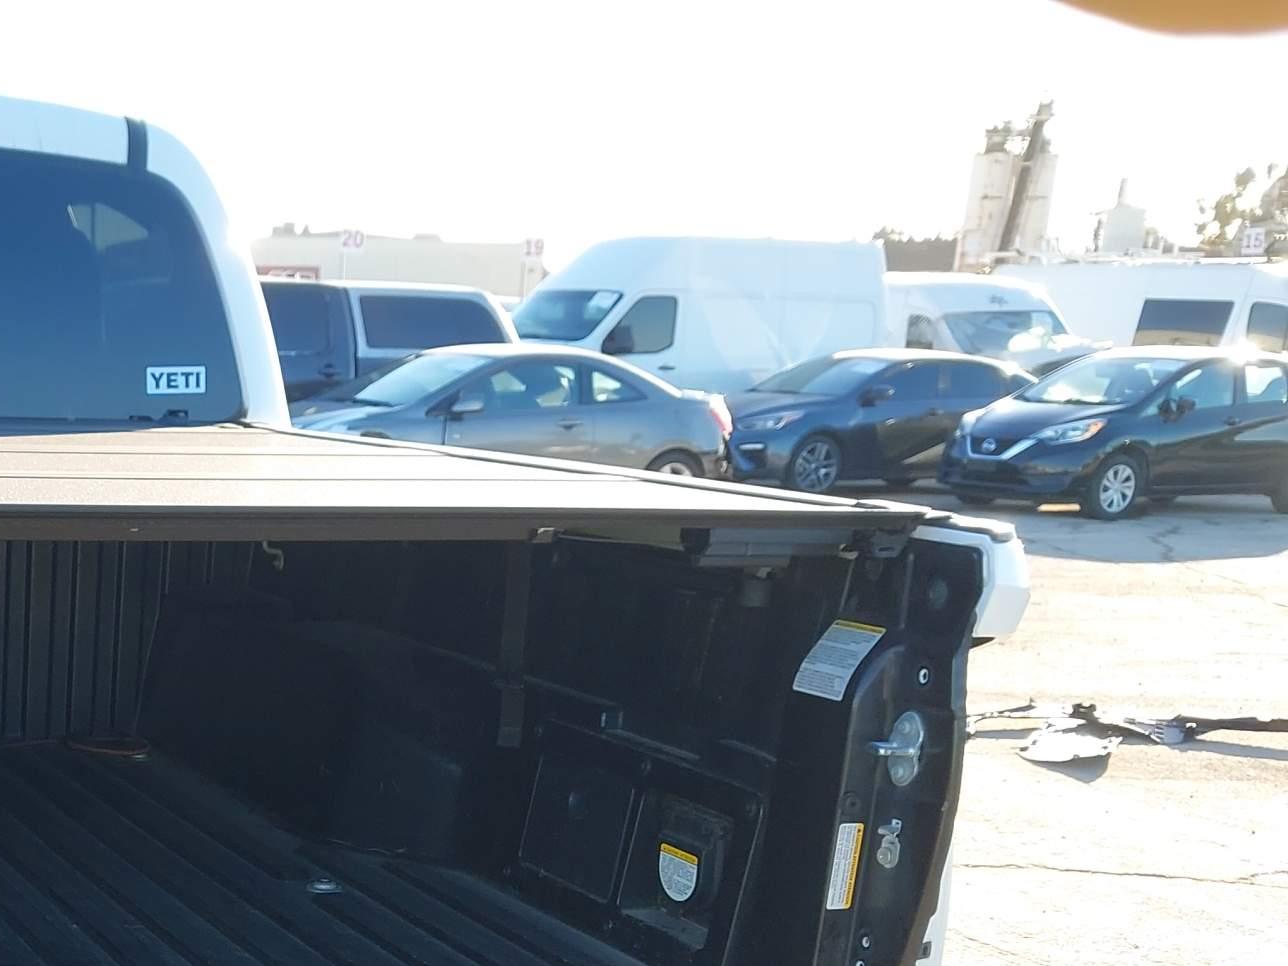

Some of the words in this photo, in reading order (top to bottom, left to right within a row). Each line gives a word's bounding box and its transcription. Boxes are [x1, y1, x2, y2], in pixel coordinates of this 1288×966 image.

[342, 230, 364, 248] 20
[525, 238, 544, 256] 19
[1246, 232, 1264, 248] 15
[150, 372, 201, 389] YETI
